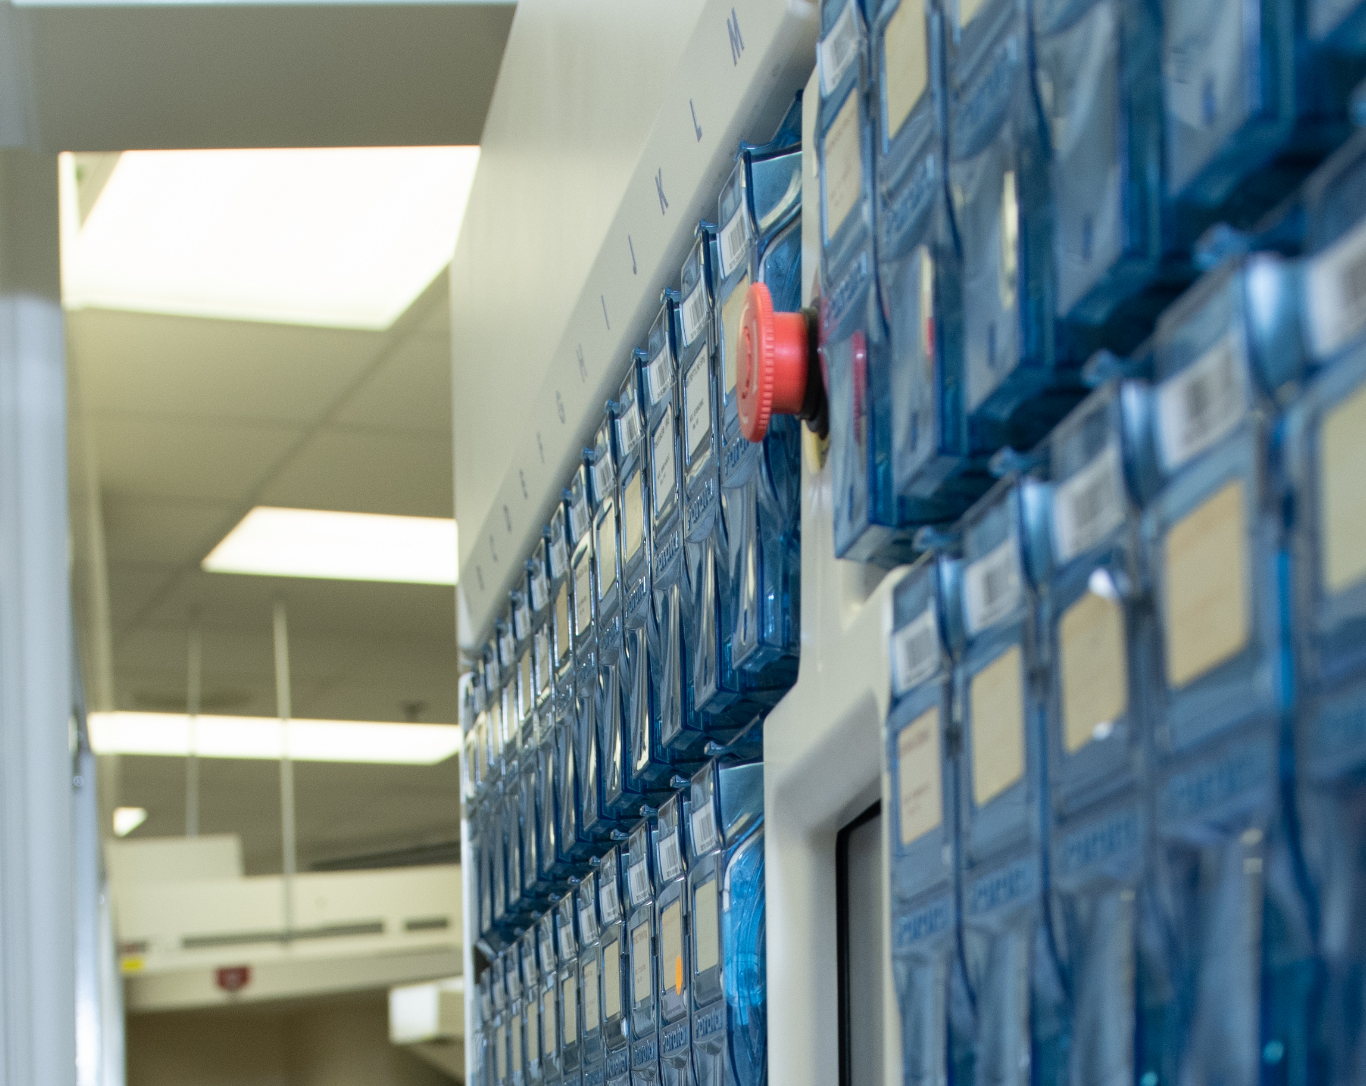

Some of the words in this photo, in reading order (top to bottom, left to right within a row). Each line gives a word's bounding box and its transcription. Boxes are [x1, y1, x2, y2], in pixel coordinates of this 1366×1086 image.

[726, 8, 745, 66] M
[689, 98, 702, 142] L
[655, 168, 668, 216] K
[628, 234, 637, 275] J
[576, 343, 588, 382] H
[687, 478, 715, 530] Parata
[655, 530, 679, 578] Parata
[663, 1024, 687, 1054] Parata
[696, 1007, 724, 1039] Parata
